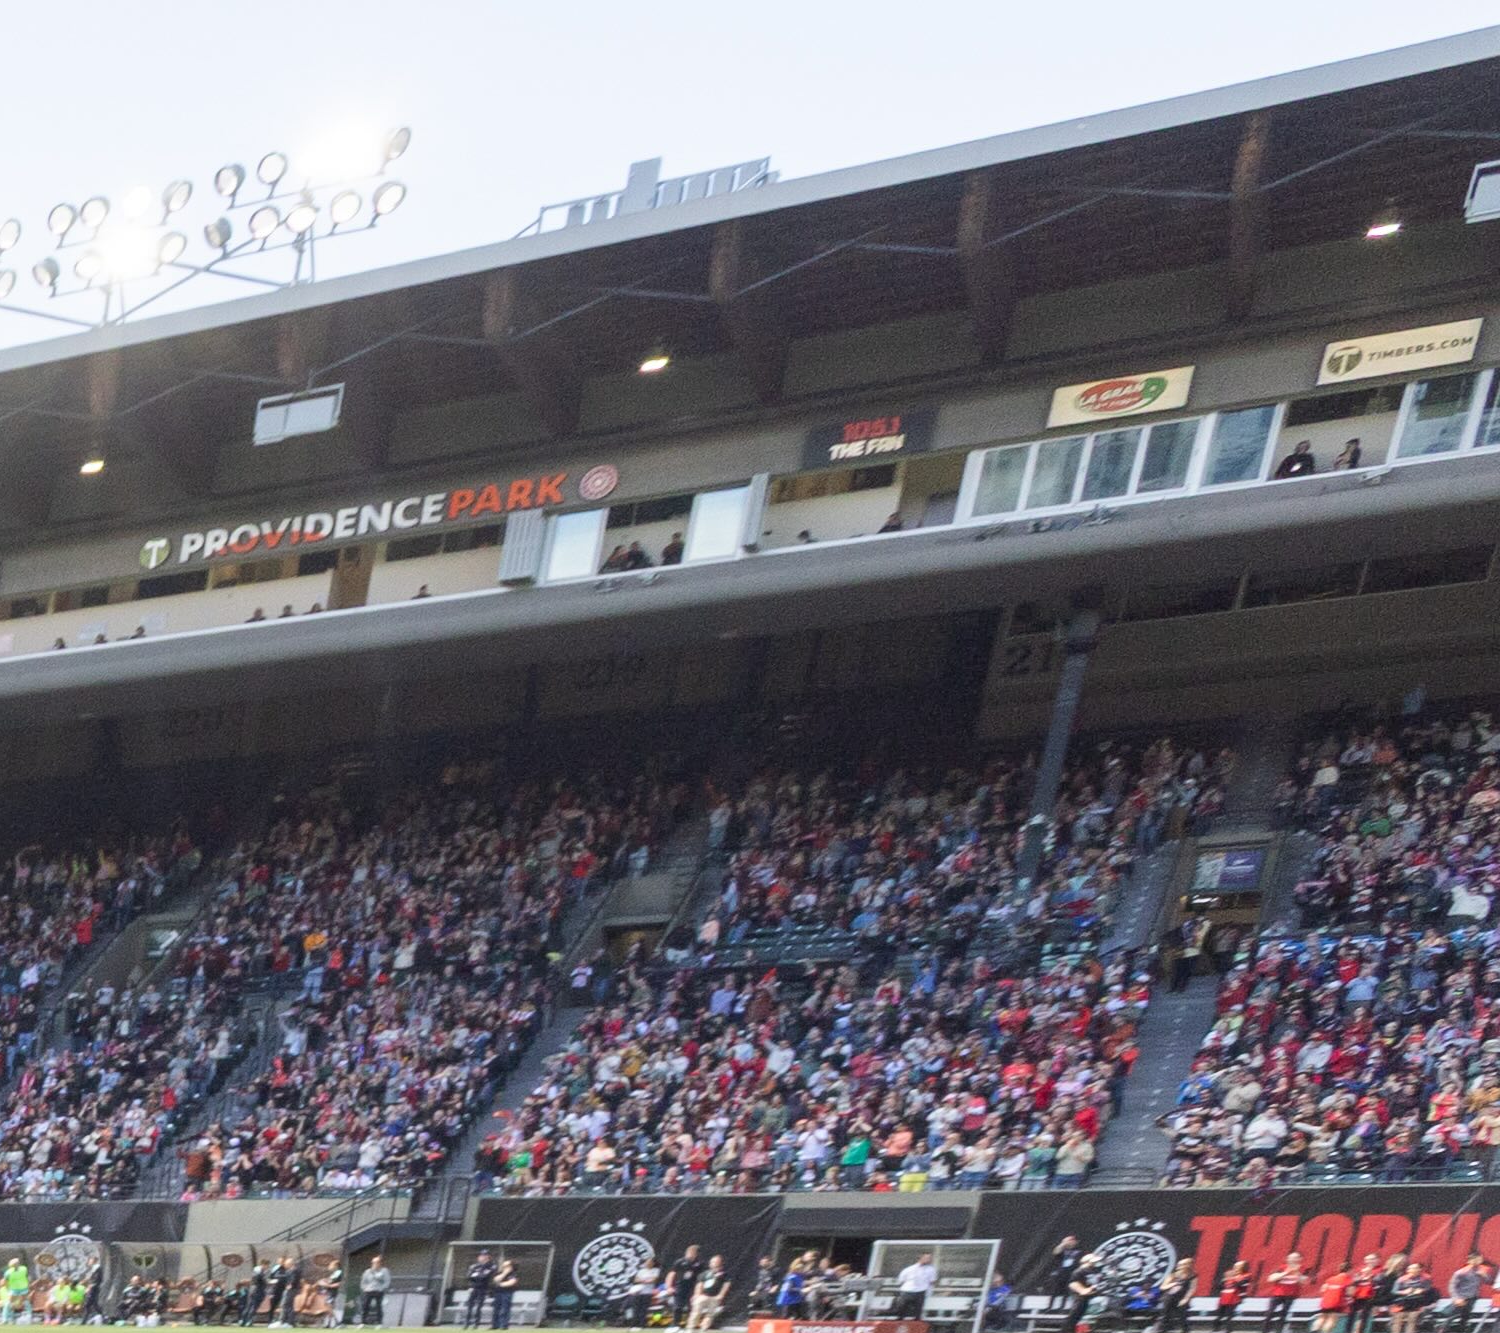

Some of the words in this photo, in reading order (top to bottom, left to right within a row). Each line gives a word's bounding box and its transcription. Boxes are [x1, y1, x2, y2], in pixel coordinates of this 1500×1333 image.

[1367, 336, 1474, 362] TIMBERS.COM
[829, 440, 865, 460] THE
[179, 493, 448, 564] PROVIDENCE
[448, 472, 568, 520] PARK
